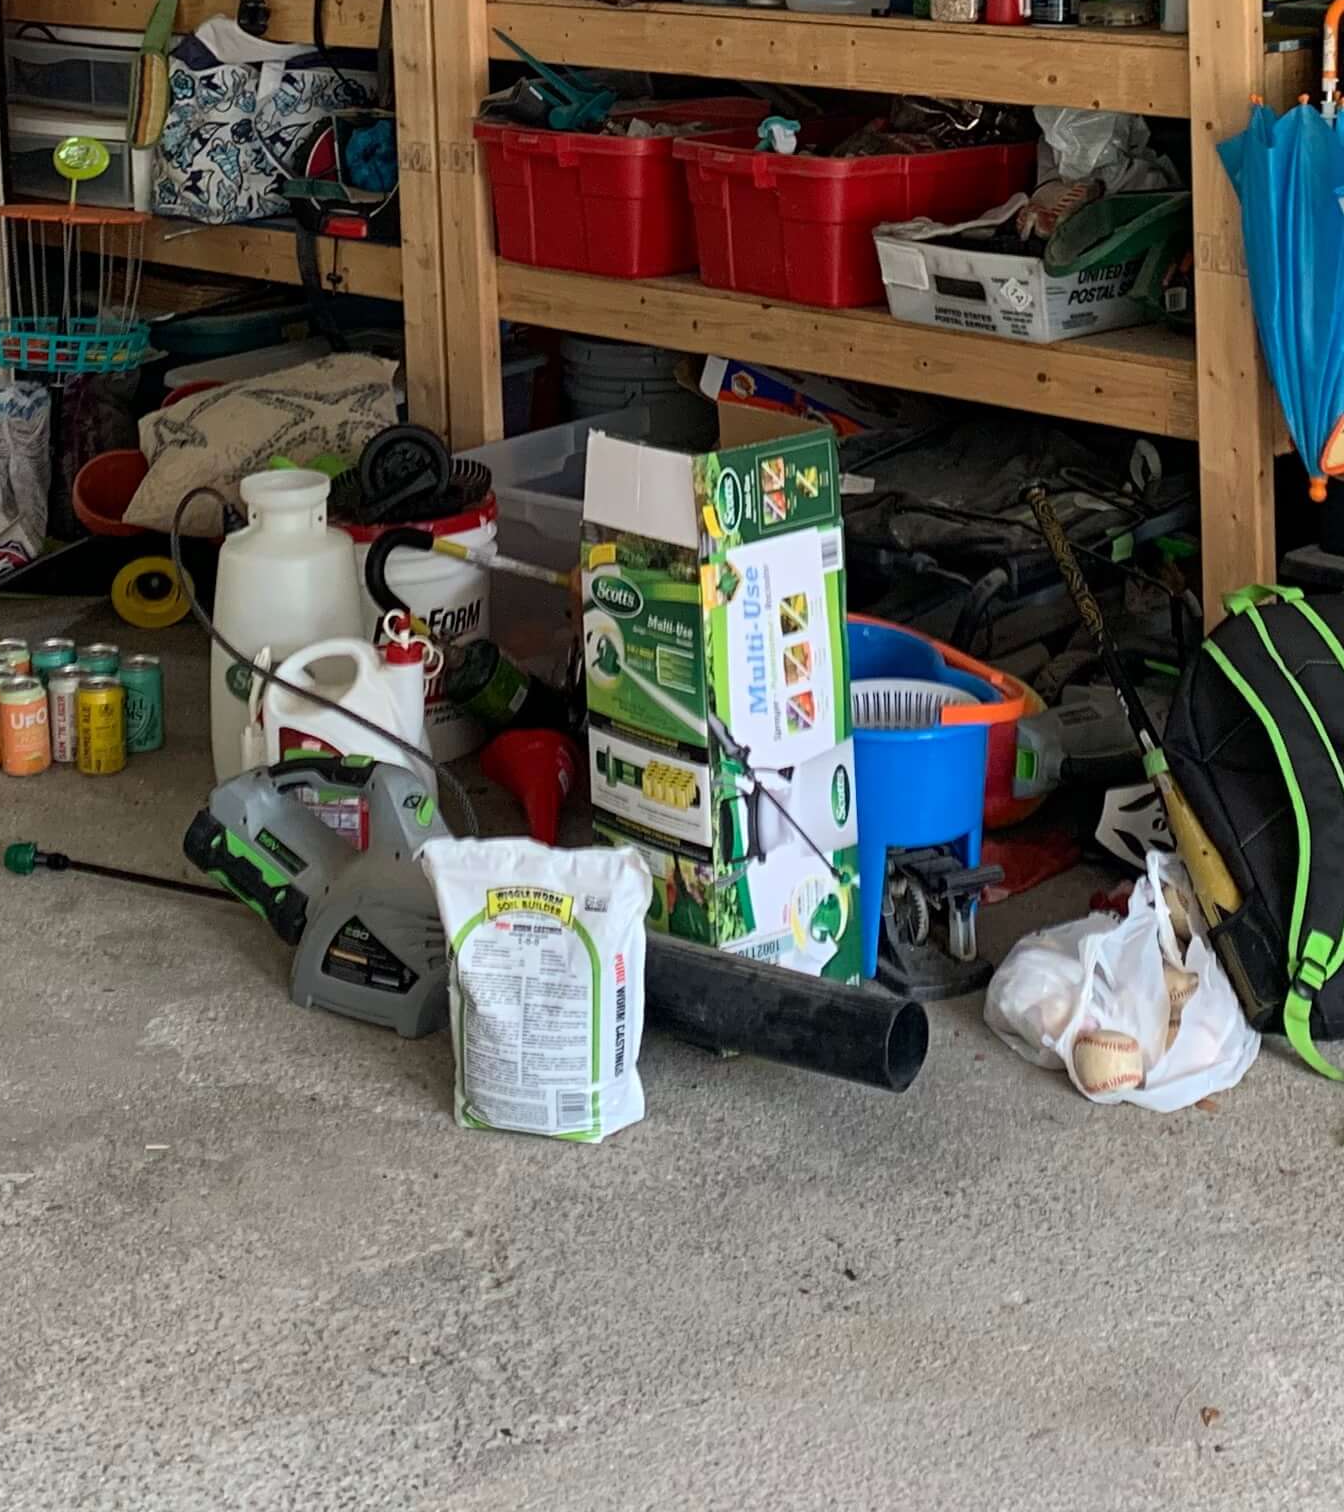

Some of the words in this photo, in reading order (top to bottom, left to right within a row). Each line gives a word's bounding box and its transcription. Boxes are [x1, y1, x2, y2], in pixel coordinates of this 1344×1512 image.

[1078, 263, 1122, 284] UNITED
[1068, 285, 1114, 305] POSTAL
[935, 306, 962, 320] UNITED
[964, 311, 992, 323] STATES
[935, 315, 963, 328] POSTAL
[597, 579, 635, 608] Scotts
[743, 566, 768, 715] Multi-Use
[10, 707, 47, 729] UFO
[836, 770, 846, 819] Scotts
[521, 900, 562, 916] BUILDER
[533, 891, 564, 905] WORM
[615, 952, 625, 984] PURE
[616, 985, 626, 1023] WORM
[615, 1024, 625, 1078] CASTINGS
